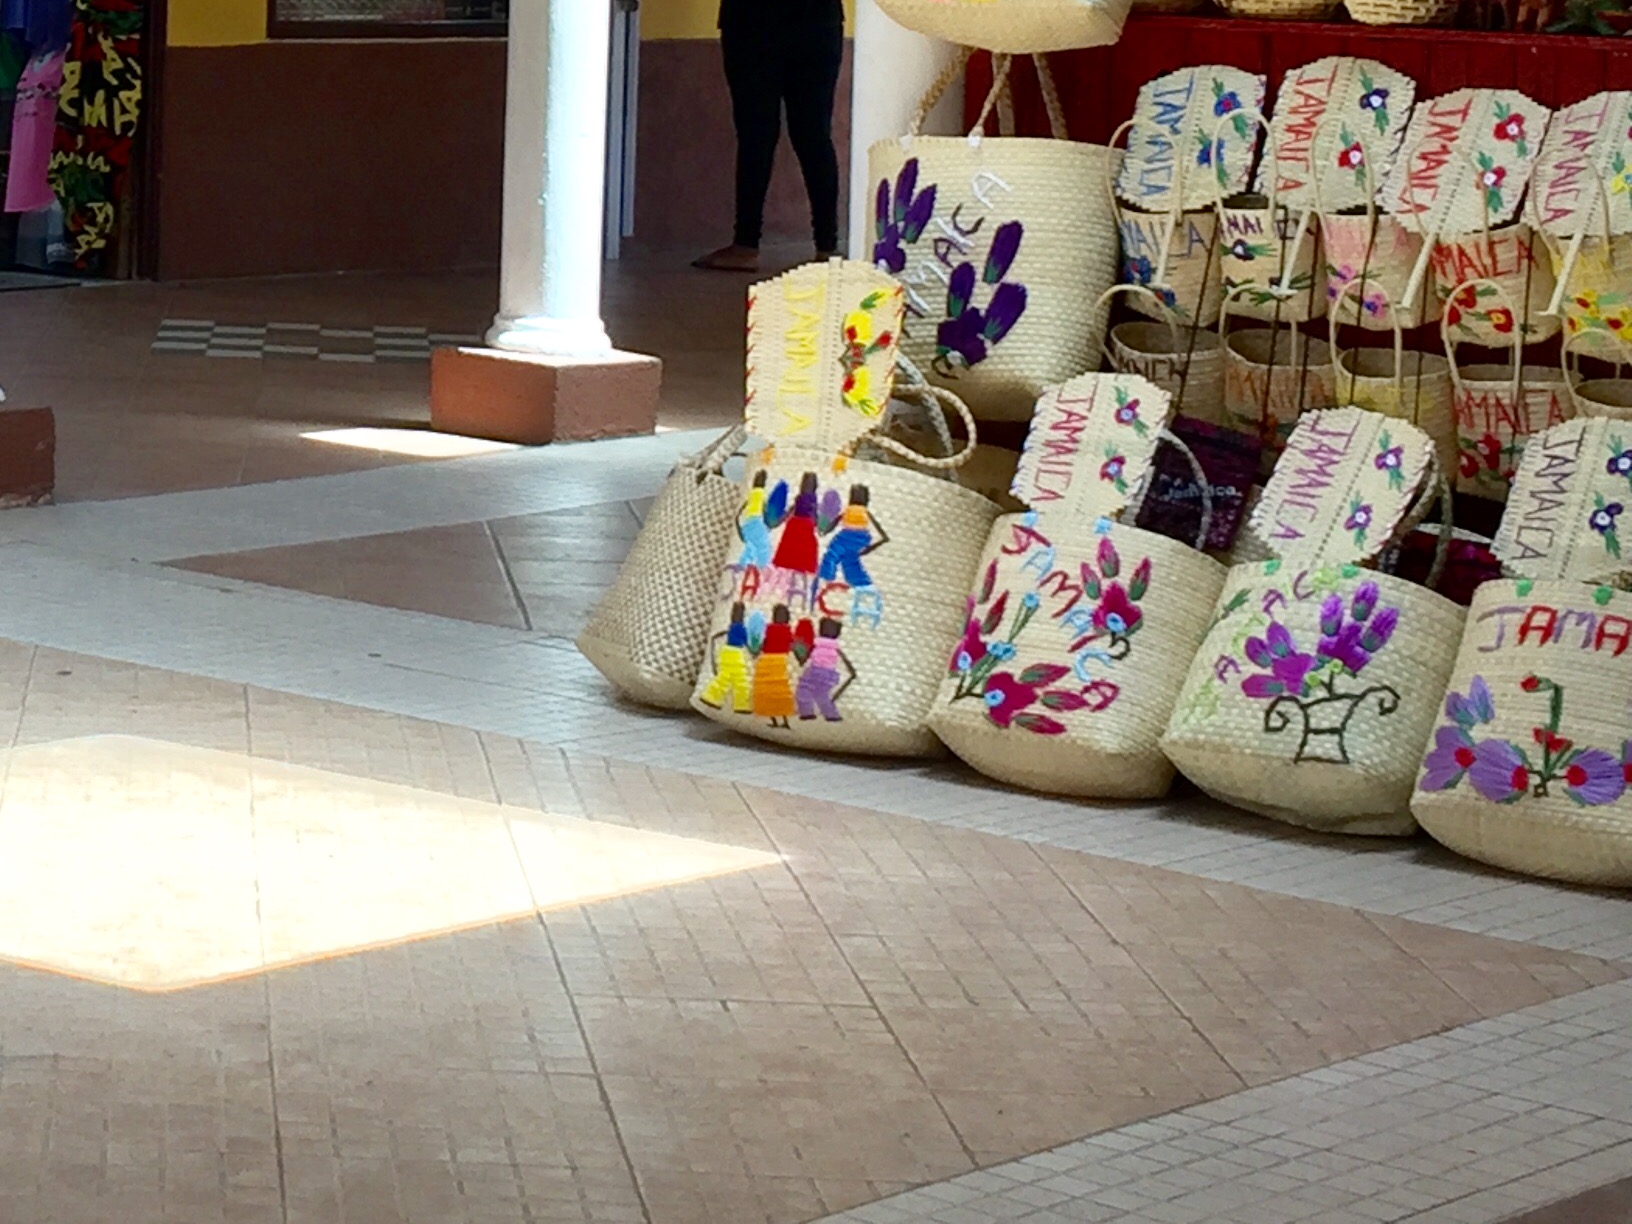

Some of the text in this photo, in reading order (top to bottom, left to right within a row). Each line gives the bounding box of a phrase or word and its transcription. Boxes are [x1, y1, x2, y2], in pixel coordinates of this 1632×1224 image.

[1029, 378, 1100, 503] JAMAICA
[1270, 410, 1365, 542] JAMAICA
[1509, 426, 1586, 562] JAMAICA
[720, 562, 884, 631] JAMAICA
